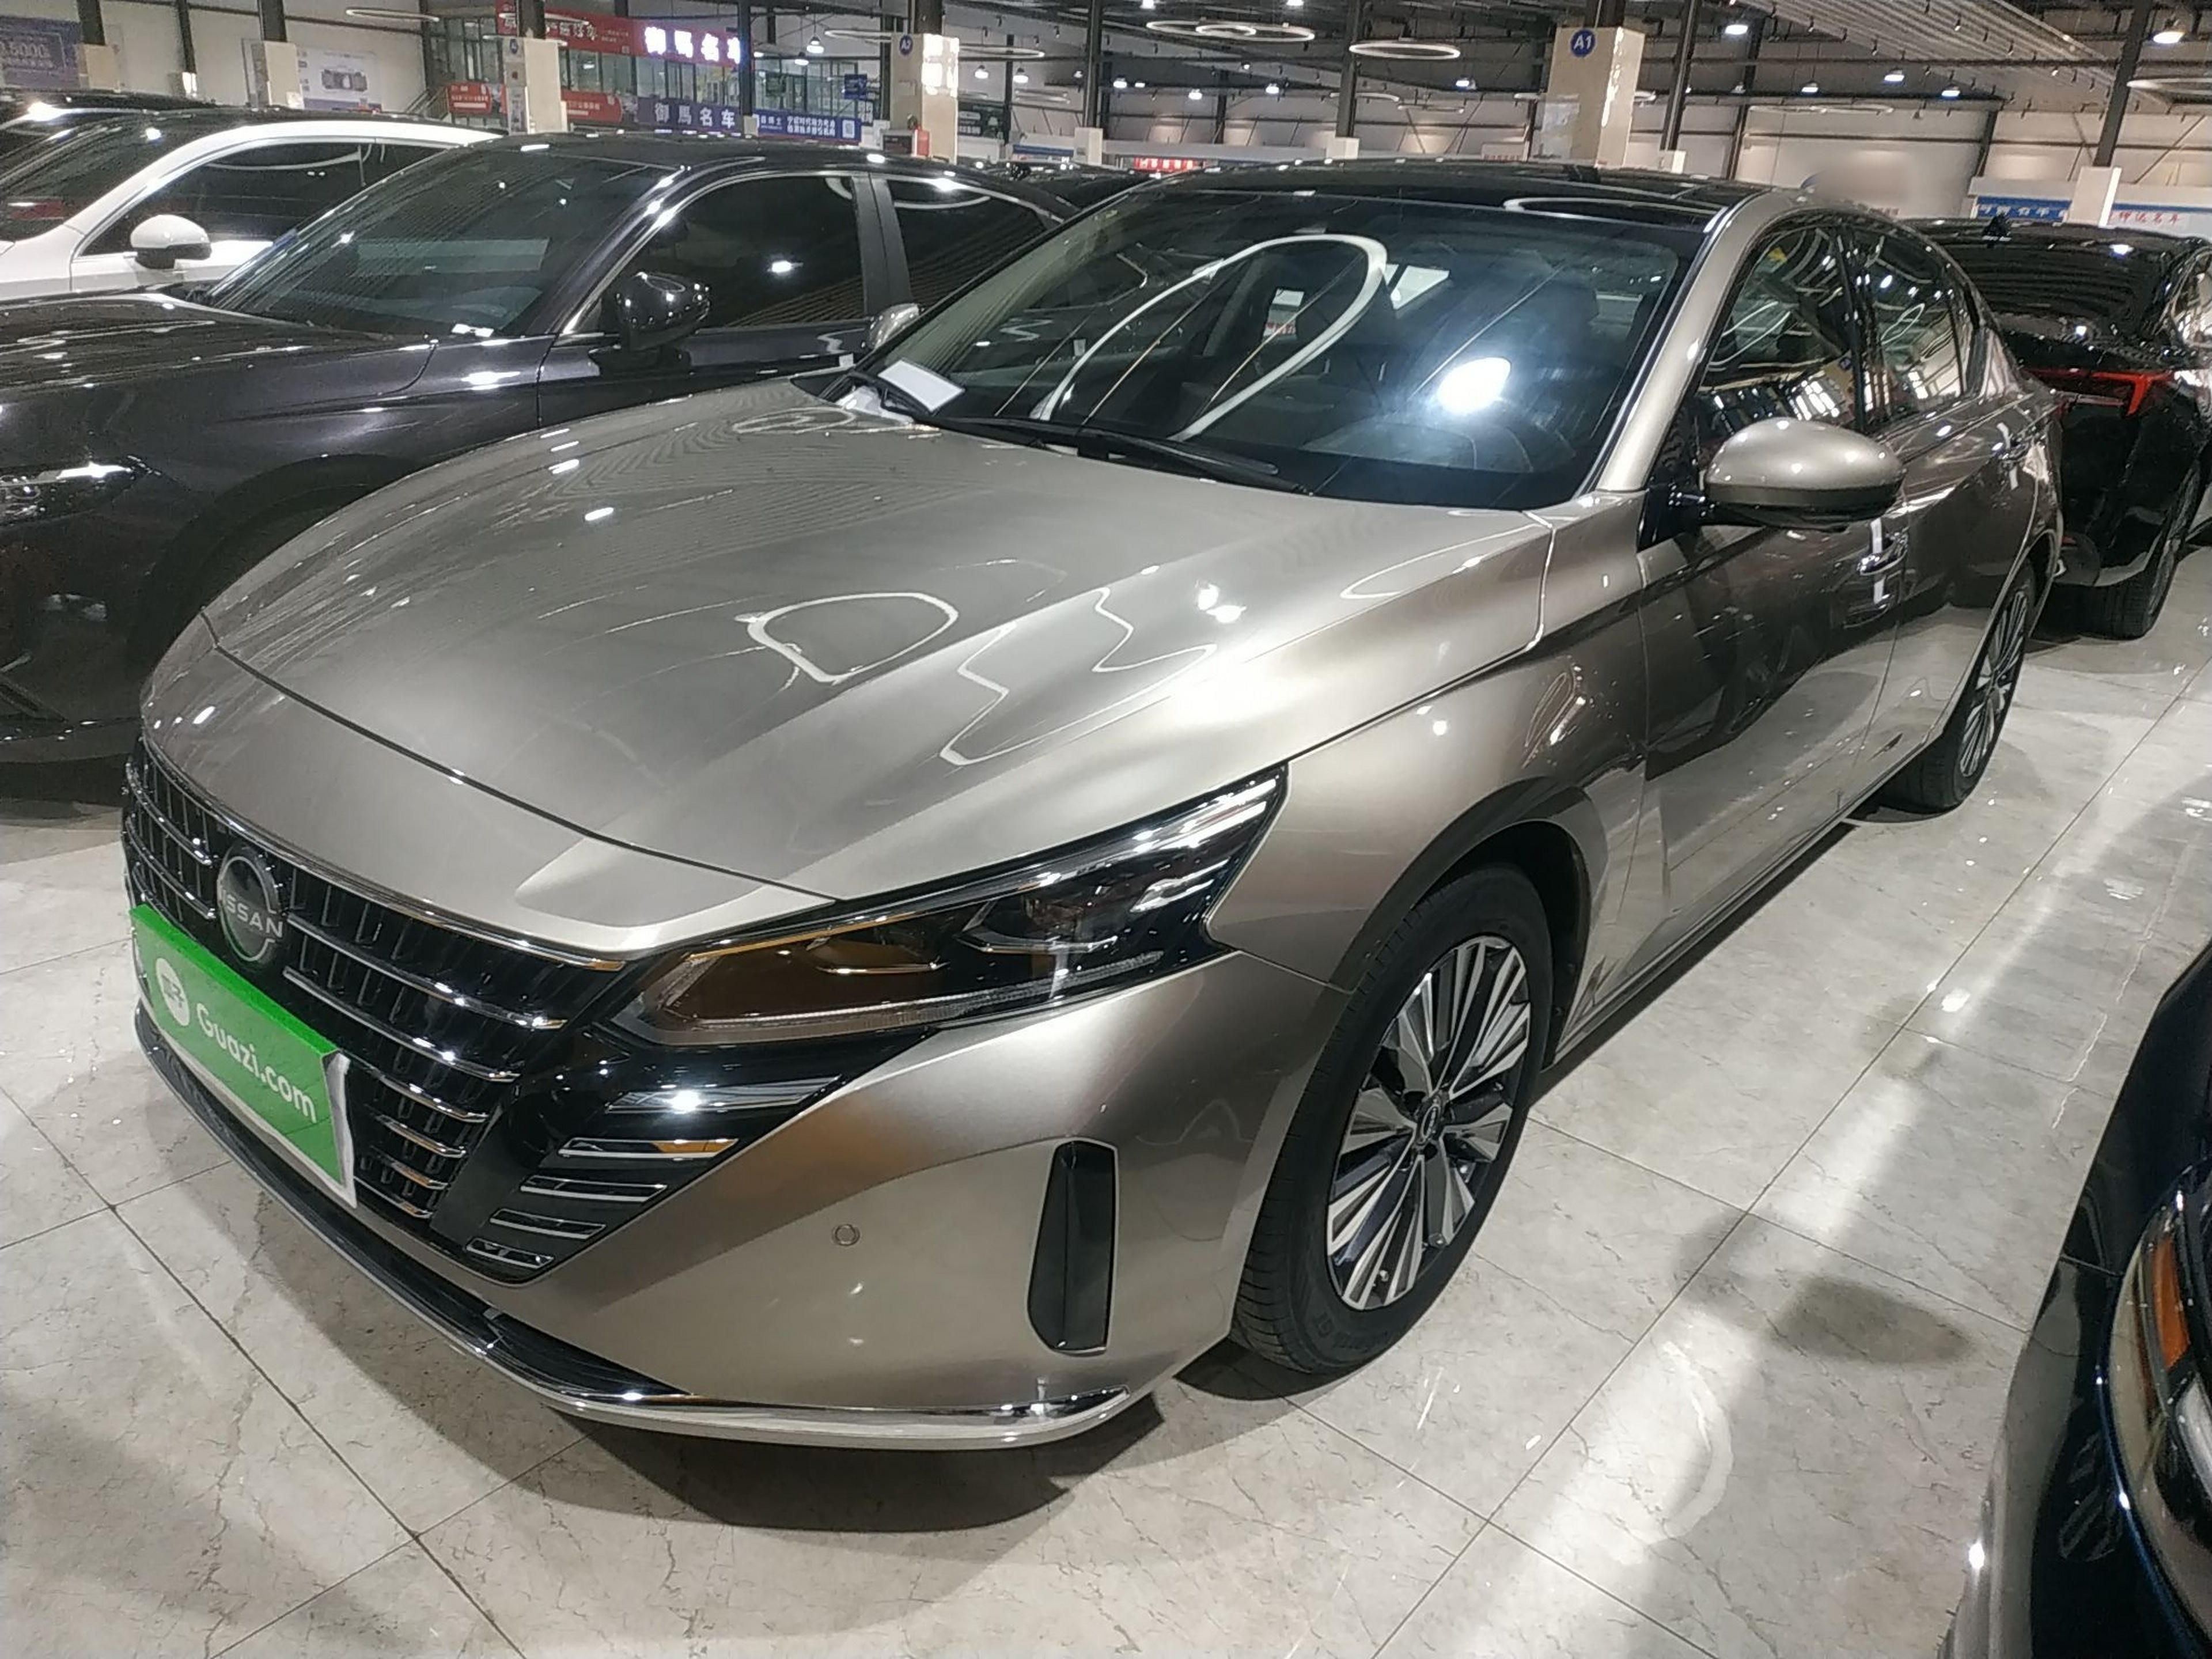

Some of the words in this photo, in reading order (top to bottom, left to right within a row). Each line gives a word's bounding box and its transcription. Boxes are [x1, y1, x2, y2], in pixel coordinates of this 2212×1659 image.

[902, 39, 911, 50] A2
[1573, 34, 1592, 50] A1
[196, 1003, 316, 1124] Guazi.com
